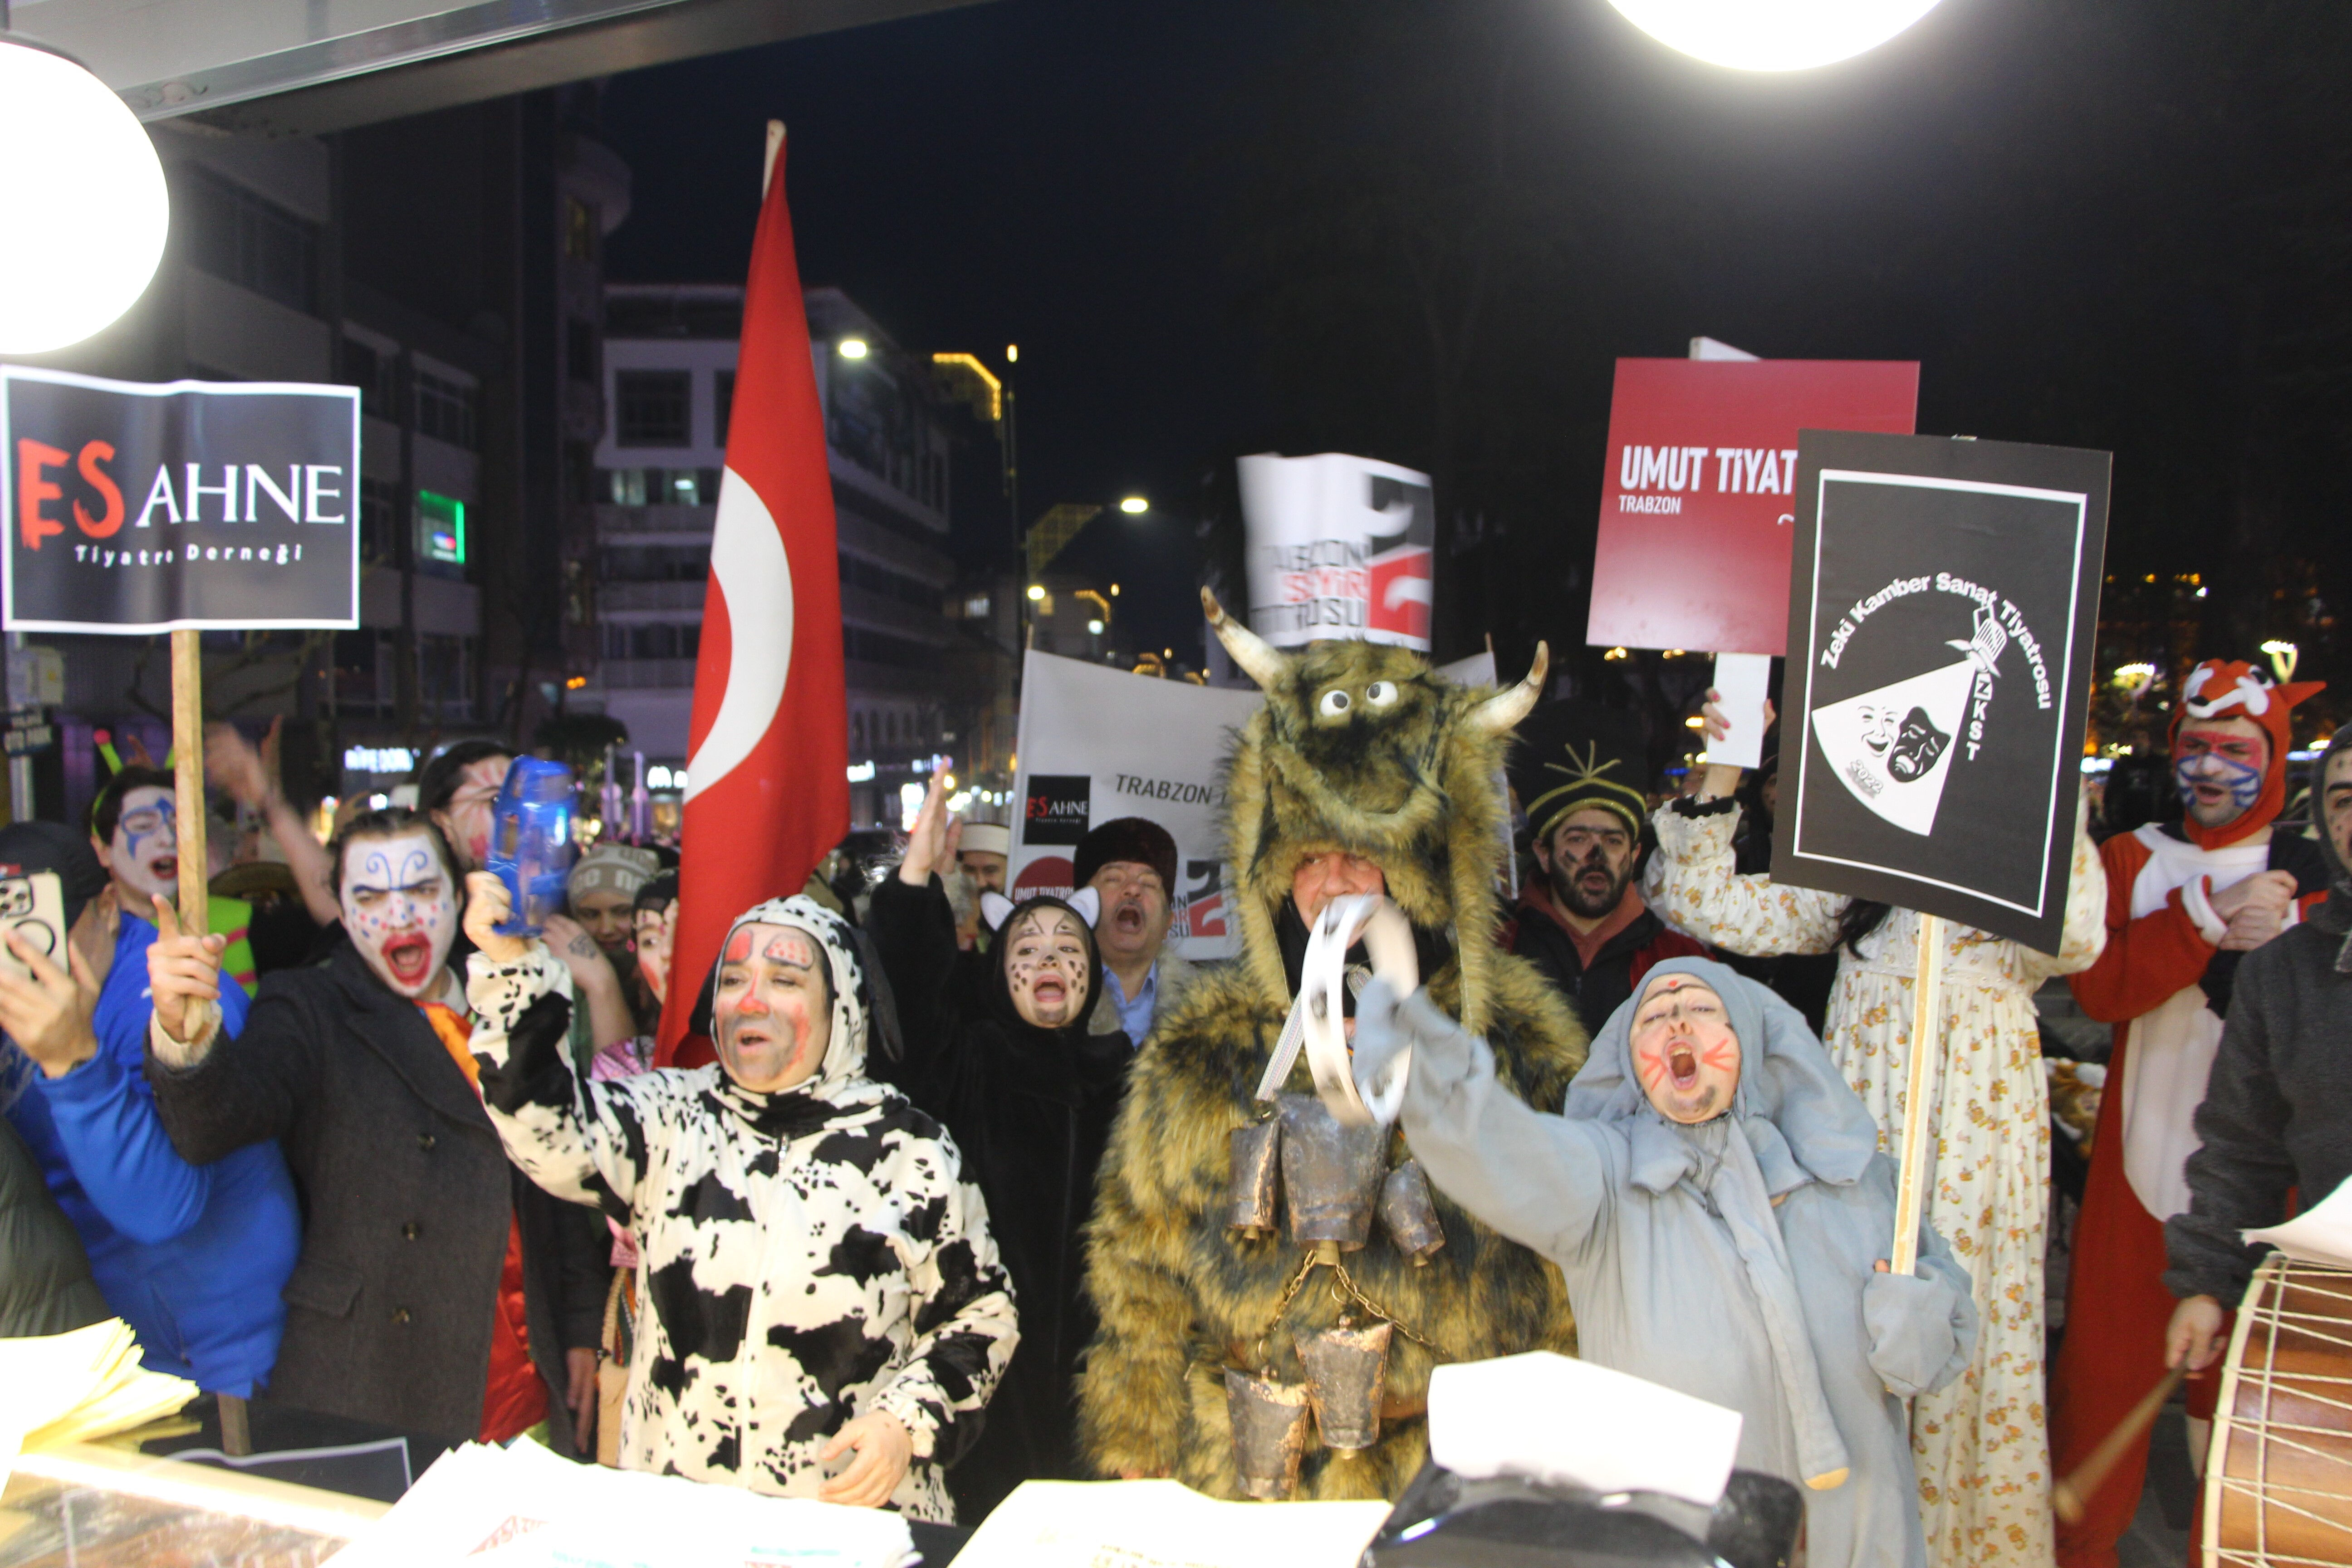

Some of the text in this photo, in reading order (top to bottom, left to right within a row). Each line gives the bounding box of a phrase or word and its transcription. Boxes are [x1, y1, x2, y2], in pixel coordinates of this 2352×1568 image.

[1620, 445, 1709, 492] UMUT
[1618, 494, 1681, 515] TRABZON
[186, 543, 302, 566] Derneği
[1820, 571, 2052, 710] Zeki Kamber Sanat Tiyatrosu
[1116, 773, 1213, 804] TRABZON
[1850, 759, 1884, 794] 2022
[1014, 887, 1037, 902] UMUT
